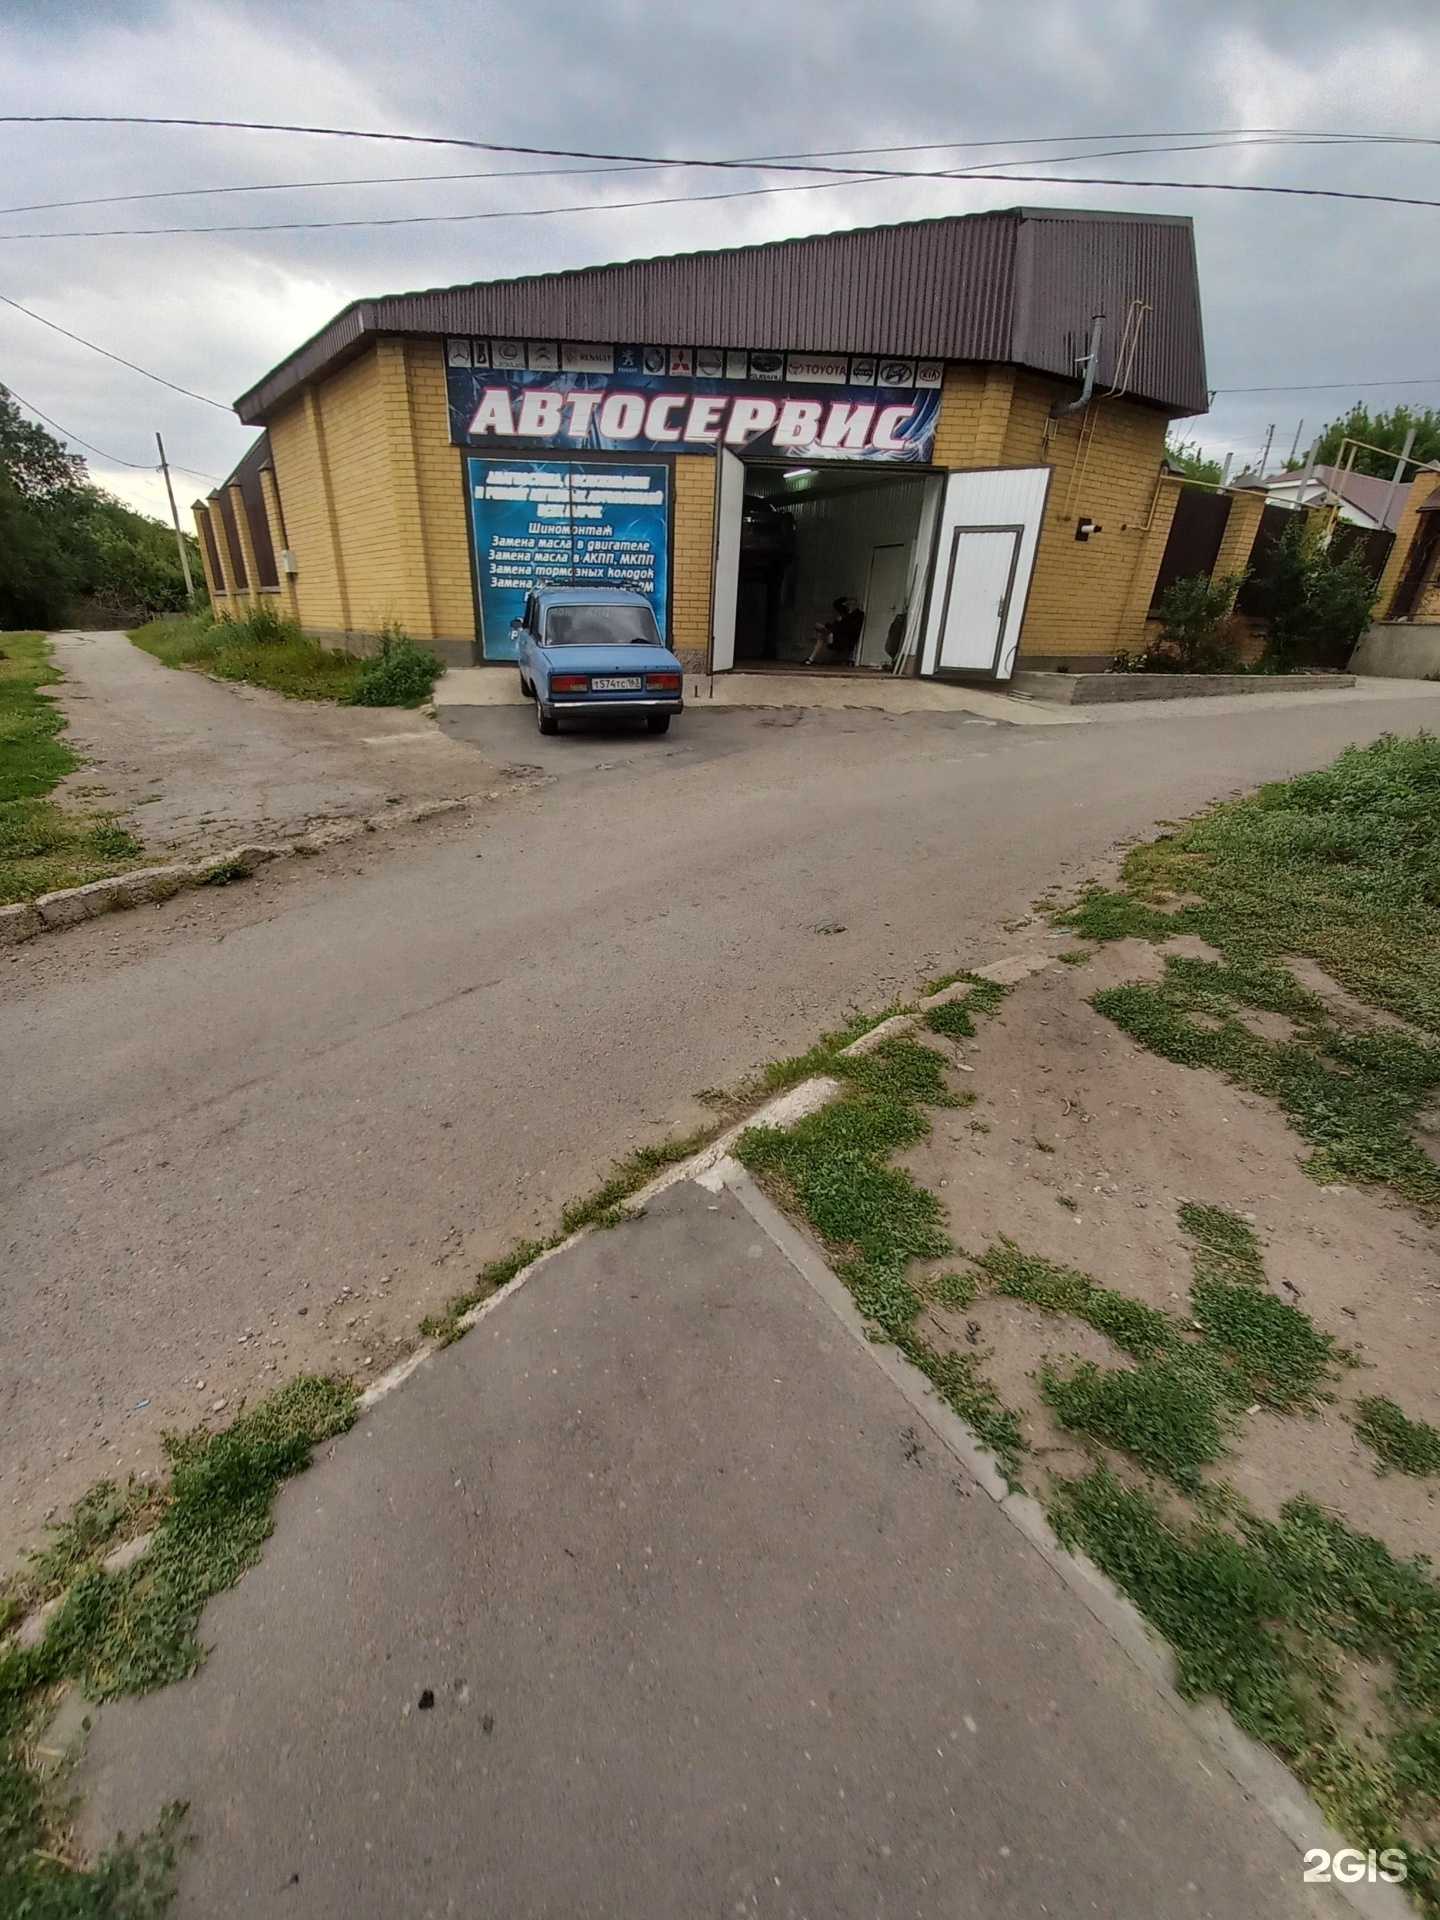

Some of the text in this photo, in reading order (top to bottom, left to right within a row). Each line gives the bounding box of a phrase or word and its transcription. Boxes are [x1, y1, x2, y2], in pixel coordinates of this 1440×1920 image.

[806, 364, 847, 376] TOYOTA
[468, 387, 914, 450] АВТОСЕРВИС
[528, 522, 613, 536] Шиномонтаж
[491, 535, 650, 551] Замена масла в двигателе
[488, 549, 531, 562] Замена
[534, 552, 568, 563] масла
[573, 555, 580, 563] в
[620, 554, 654, 566] МКПП
[489, 563, 654, 580] Замена тормозных колодок
[491, 577, 533, 589] Замена
